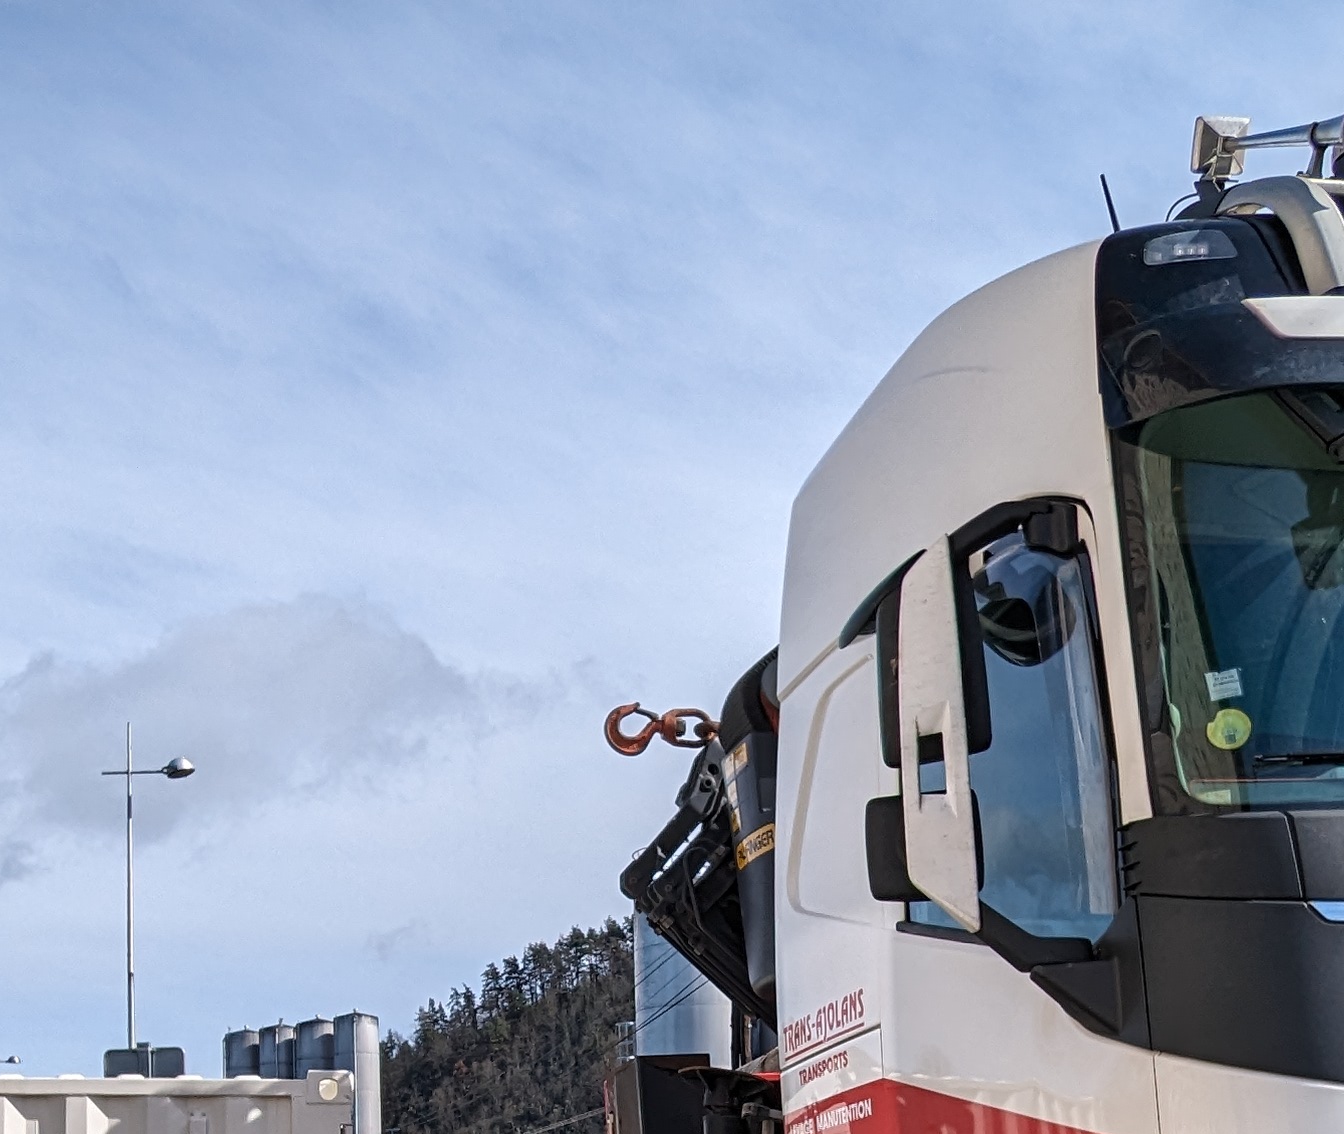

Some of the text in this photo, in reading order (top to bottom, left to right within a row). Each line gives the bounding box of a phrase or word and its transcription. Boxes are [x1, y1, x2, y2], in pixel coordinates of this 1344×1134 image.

[783, 988, 864, 1054] TRANS-AJOLANS
[799, 1050, 848, 1086] TRANSPORTS
[816, 1098, 872, 1132] MANUTENTION
